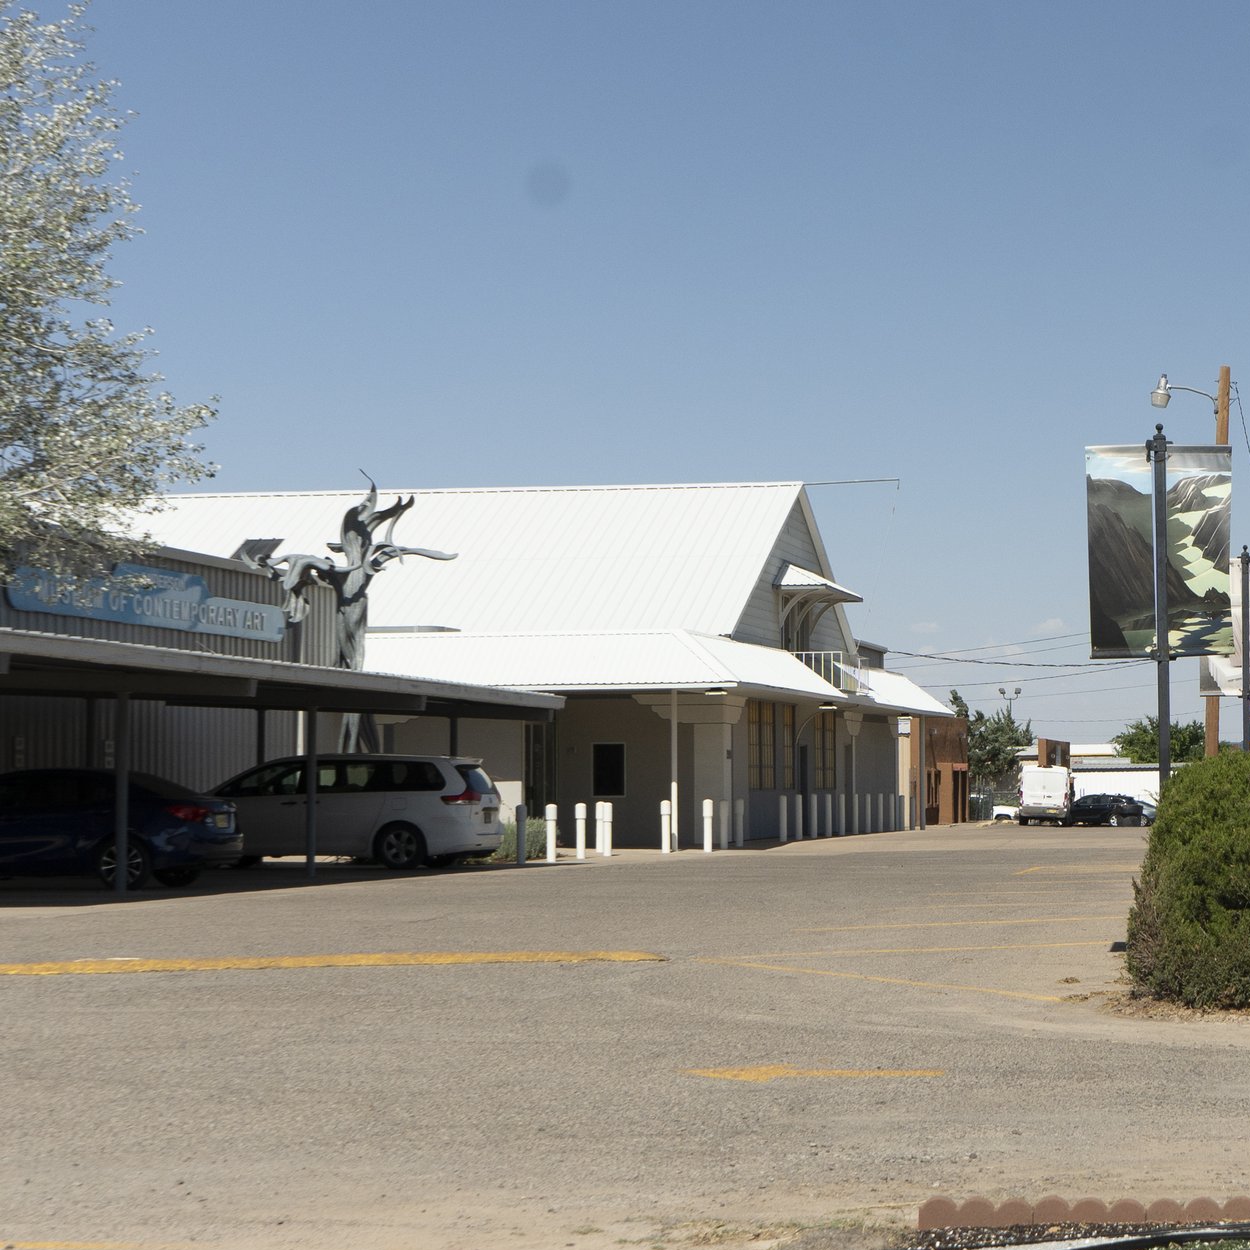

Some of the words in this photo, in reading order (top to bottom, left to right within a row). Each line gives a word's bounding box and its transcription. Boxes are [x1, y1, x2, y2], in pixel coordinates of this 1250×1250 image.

[109, 590, 128, 612] OF
[133, 594, 240, 627] CONTEMPORARY
[244, 609, 268, 631] ART
